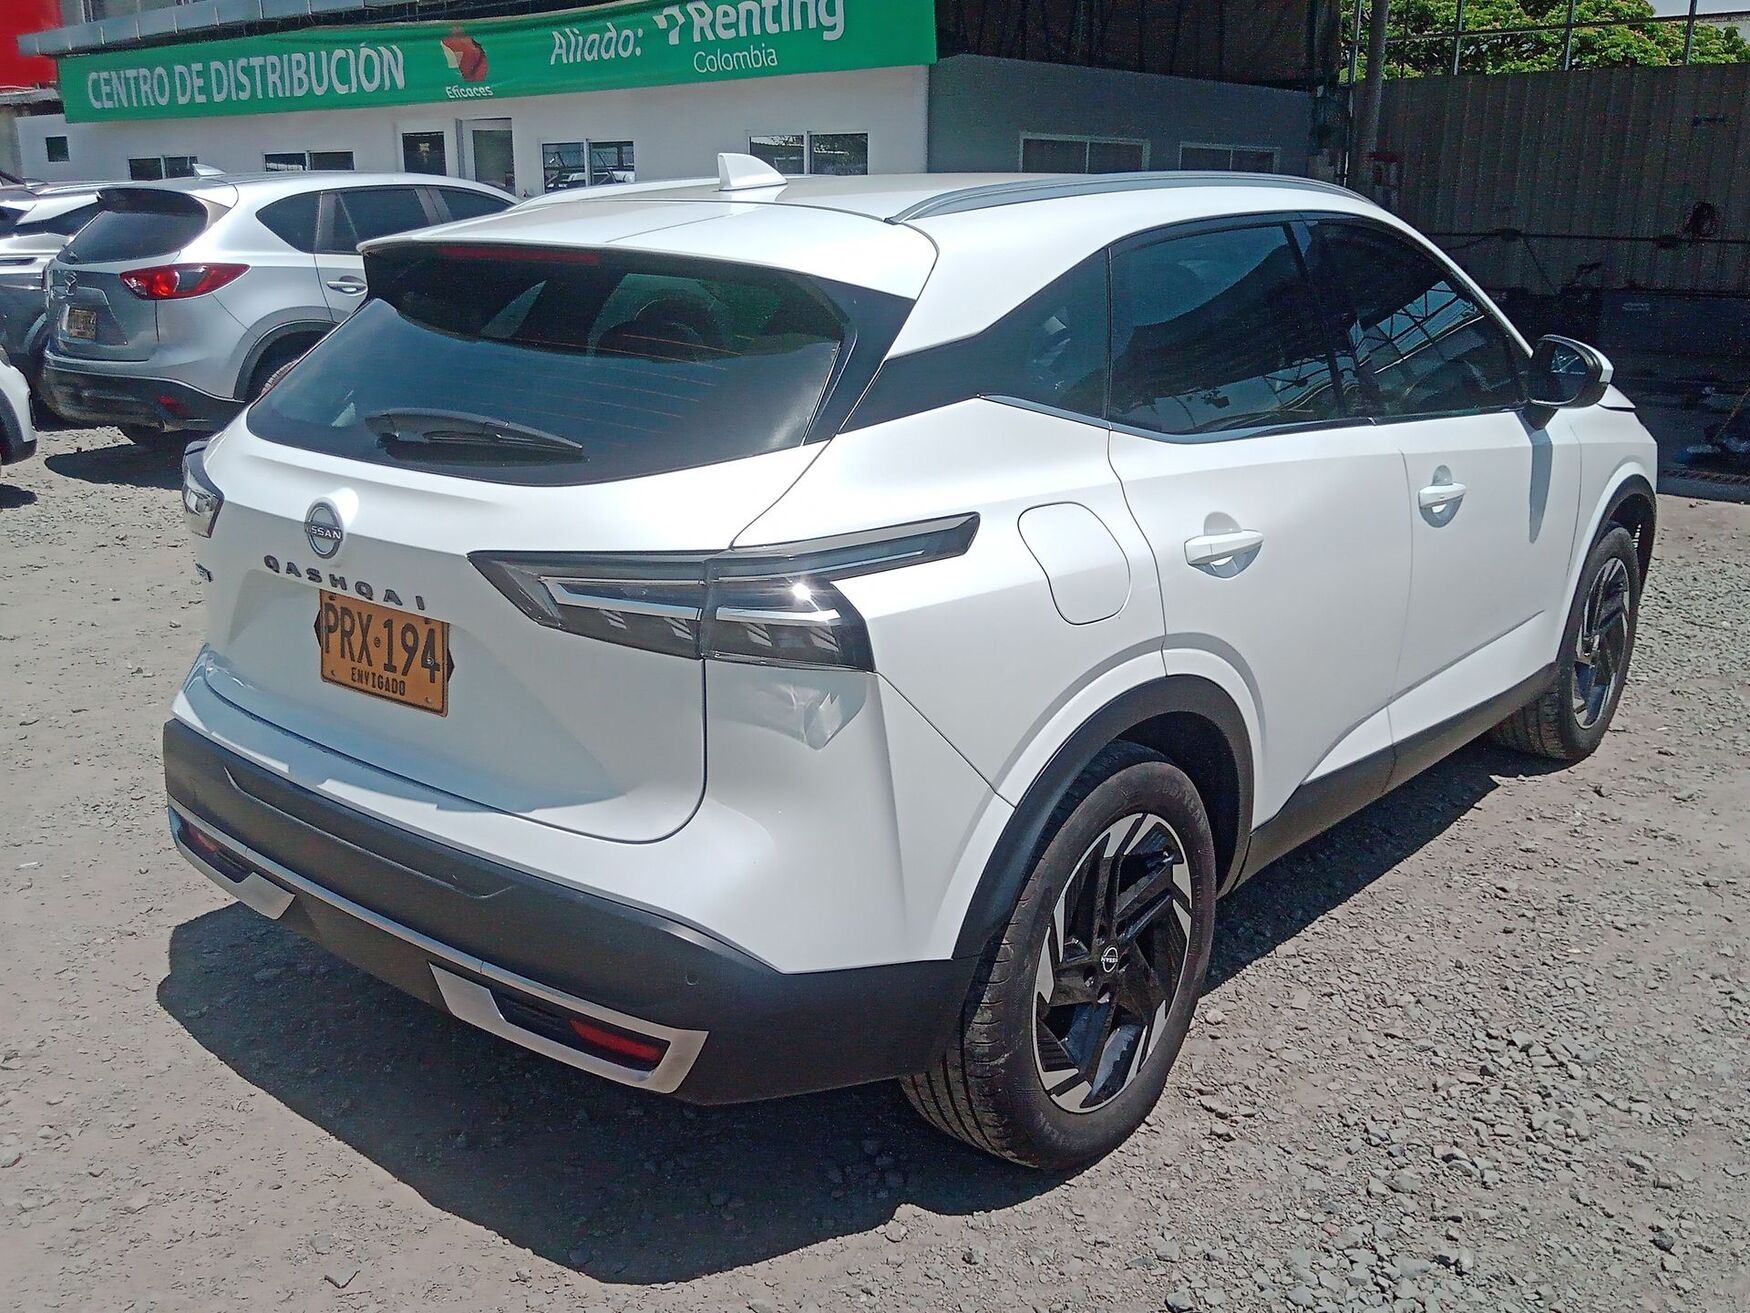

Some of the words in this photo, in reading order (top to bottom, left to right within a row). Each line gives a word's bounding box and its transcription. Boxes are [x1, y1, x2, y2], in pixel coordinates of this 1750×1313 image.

[686, 0, 845, 42] Renting
[550, 22, 644, 65] Aliado:
[693, 43, 778, 73] Colombia
[87, 66, 170, 109] CENTRO
[174, 62, 207, 105] DE
[210, 41, 405, 103] DISTRIBUCIÓN
[445, 84, 494, 99] Eficaces
[263, 554, 425, 611] QASHQAI
[351, 667, 407, 697] ENVIGADO
